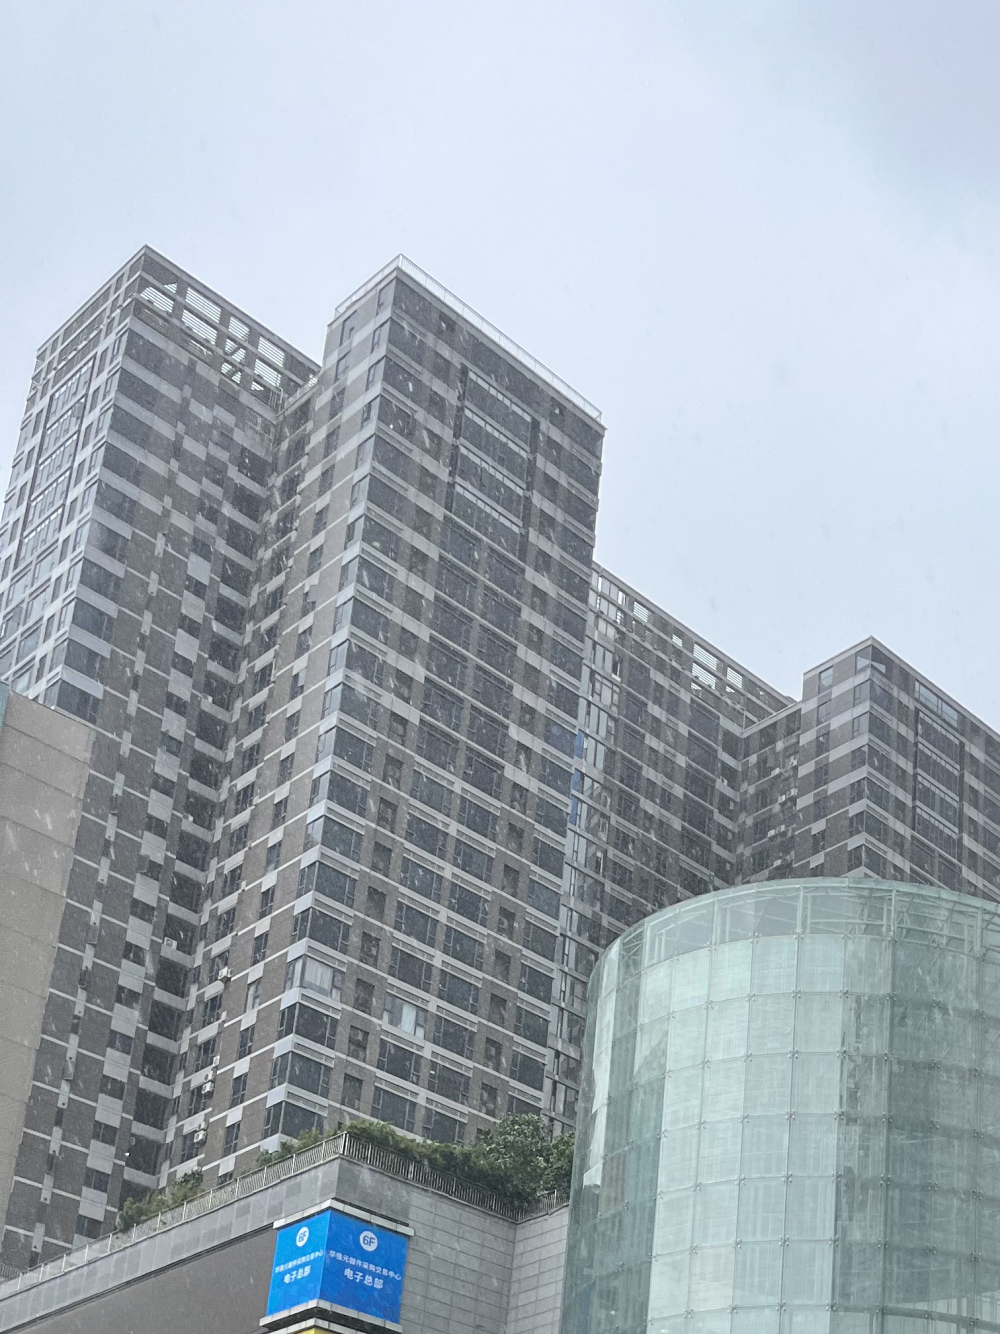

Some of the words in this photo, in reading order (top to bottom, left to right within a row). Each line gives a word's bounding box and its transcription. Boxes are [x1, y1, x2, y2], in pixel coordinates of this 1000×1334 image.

[298, 1230, 308, 1243] 6F
[362, 1235, 376, 1247] 6F
[283, 1265, 311, 1284] 电子总部
[329, 1250, 401, 1280] 华强元器件采购交易中心
[344, 1268, 384, 1289] 电子总部
